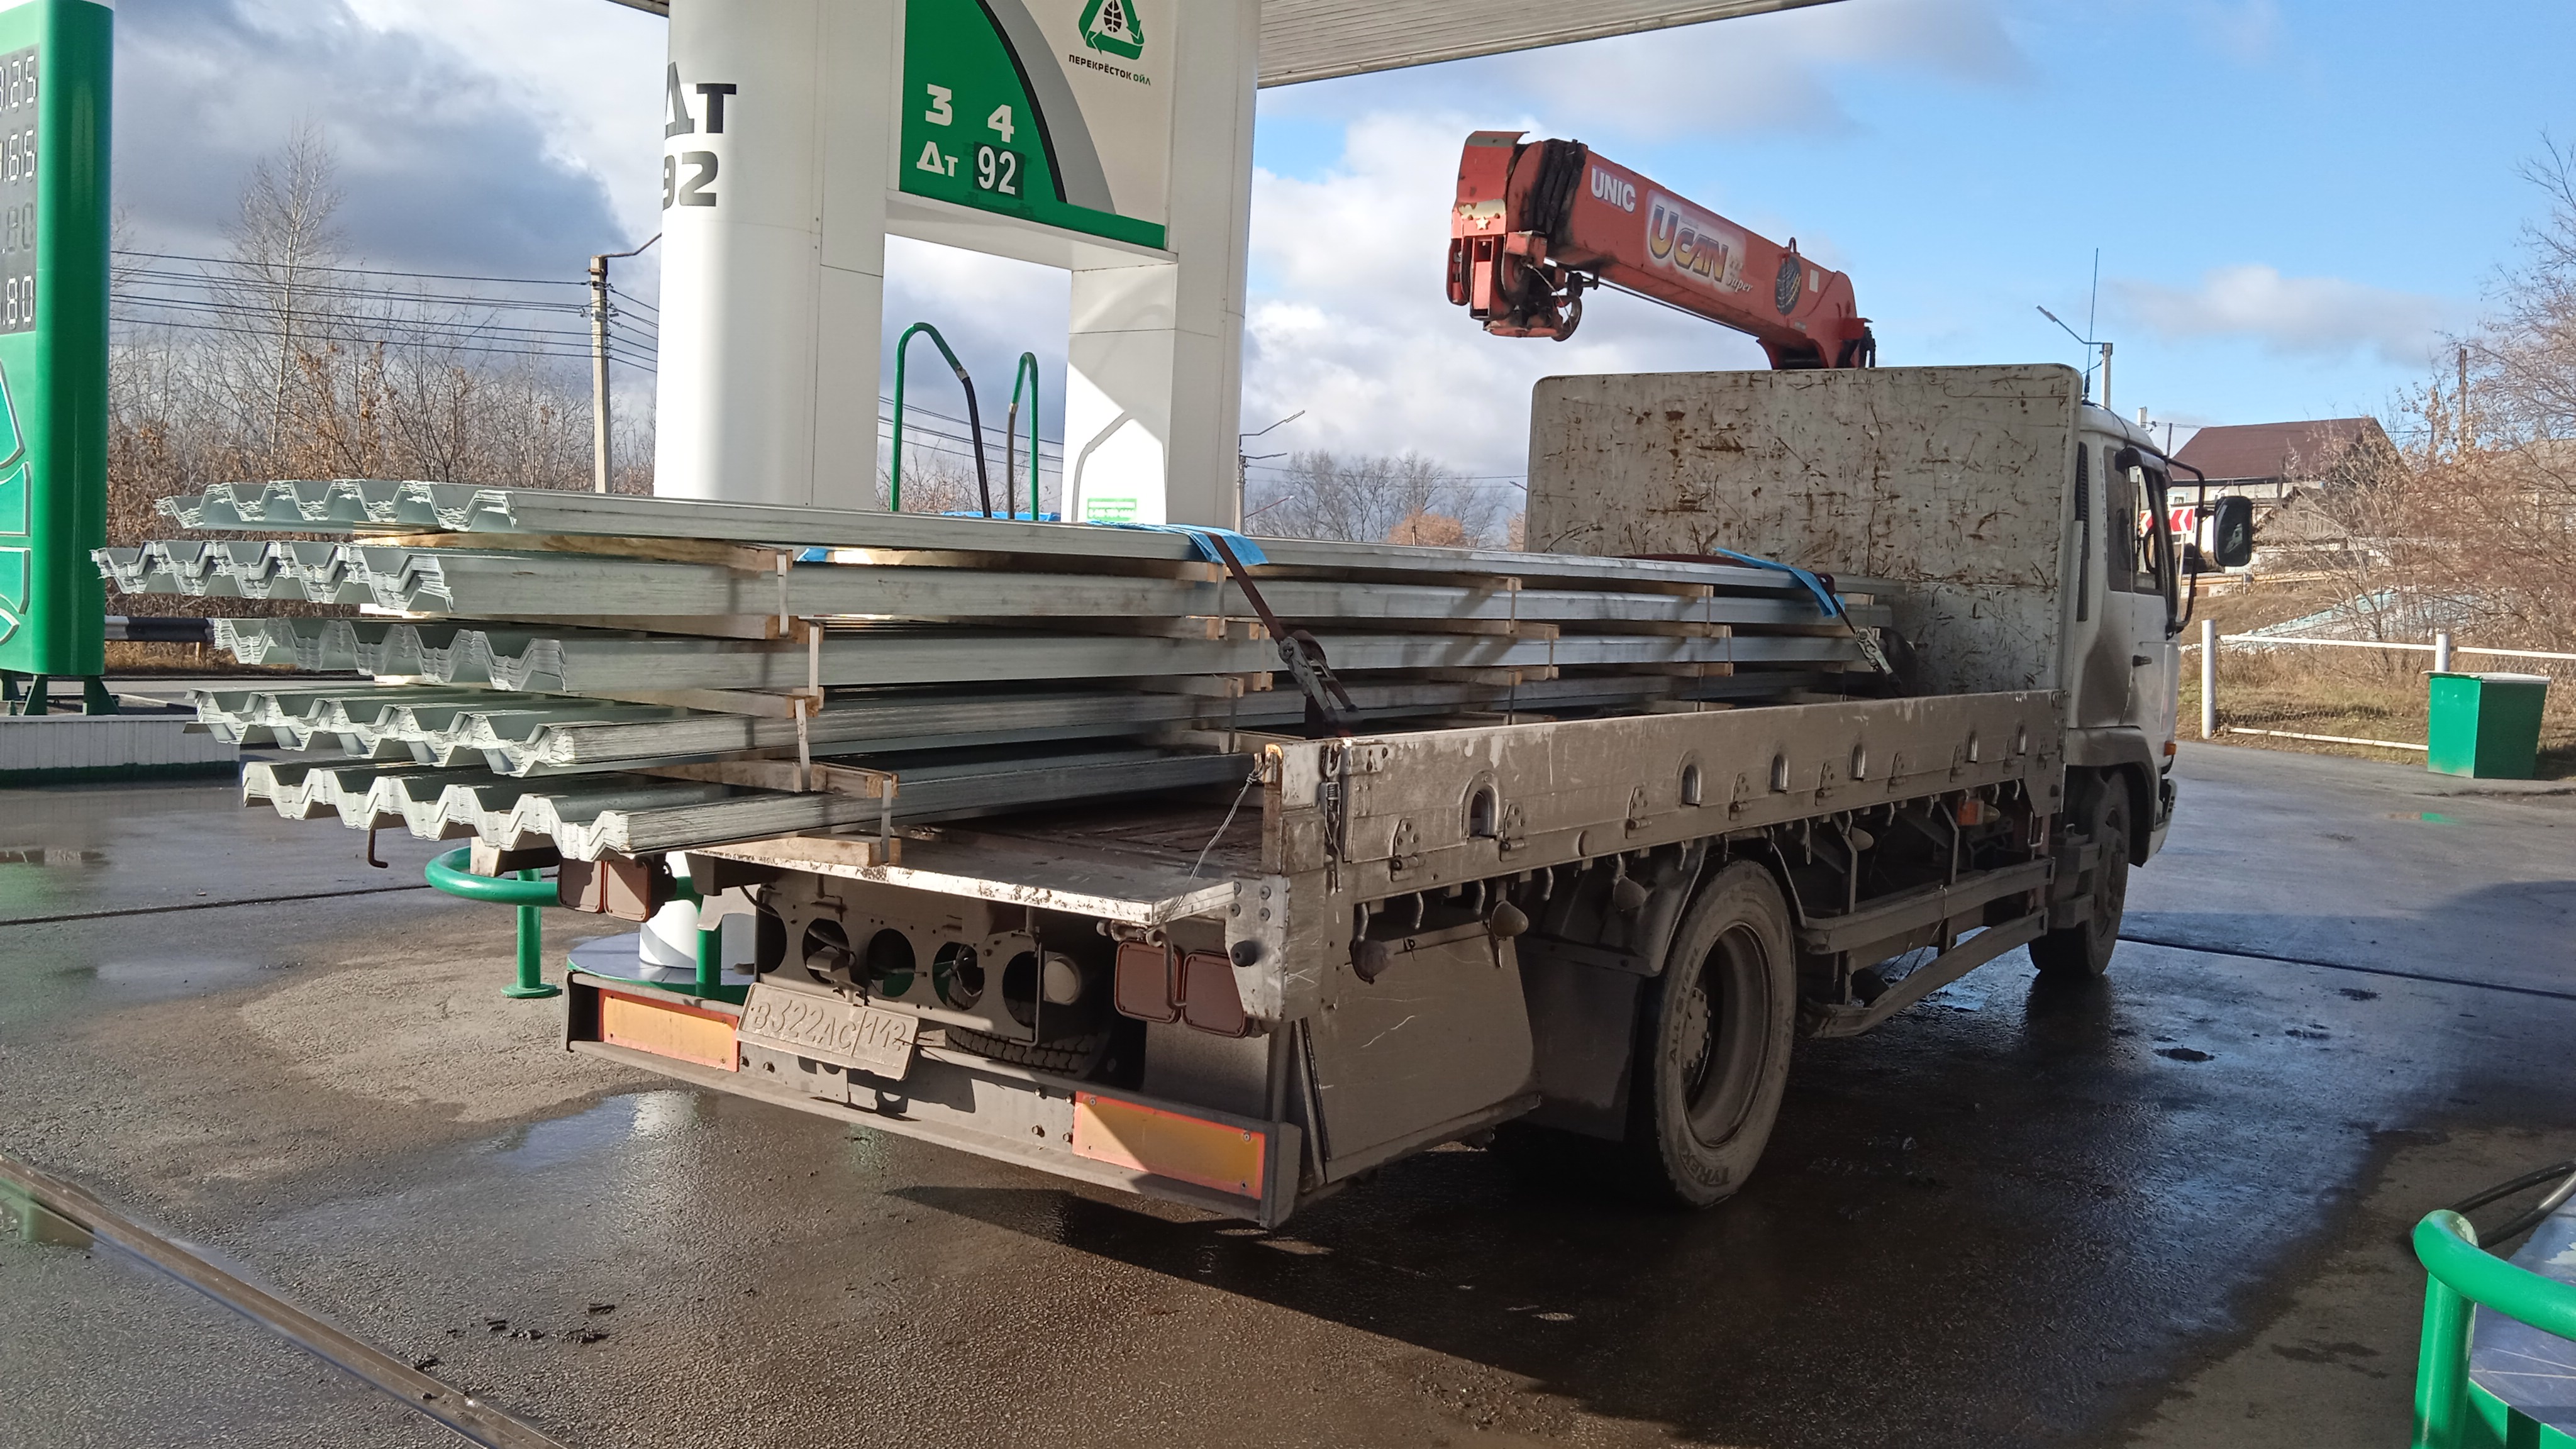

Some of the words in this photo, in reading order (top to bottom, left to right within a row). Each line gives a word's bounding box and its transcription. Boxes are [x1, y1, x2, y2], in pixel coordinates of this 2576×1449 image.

[1069, 54, 1131, 80] ПЕРЕКРЁСТОК
[1133, 74, 1152, 86] ОЙЛ
[925, 83, 953, 126] 3
[987, 104, 1014, 143] 4
[977, 145, 1017, 196] 92
[1591, 167, 1636, 213] UNIC
